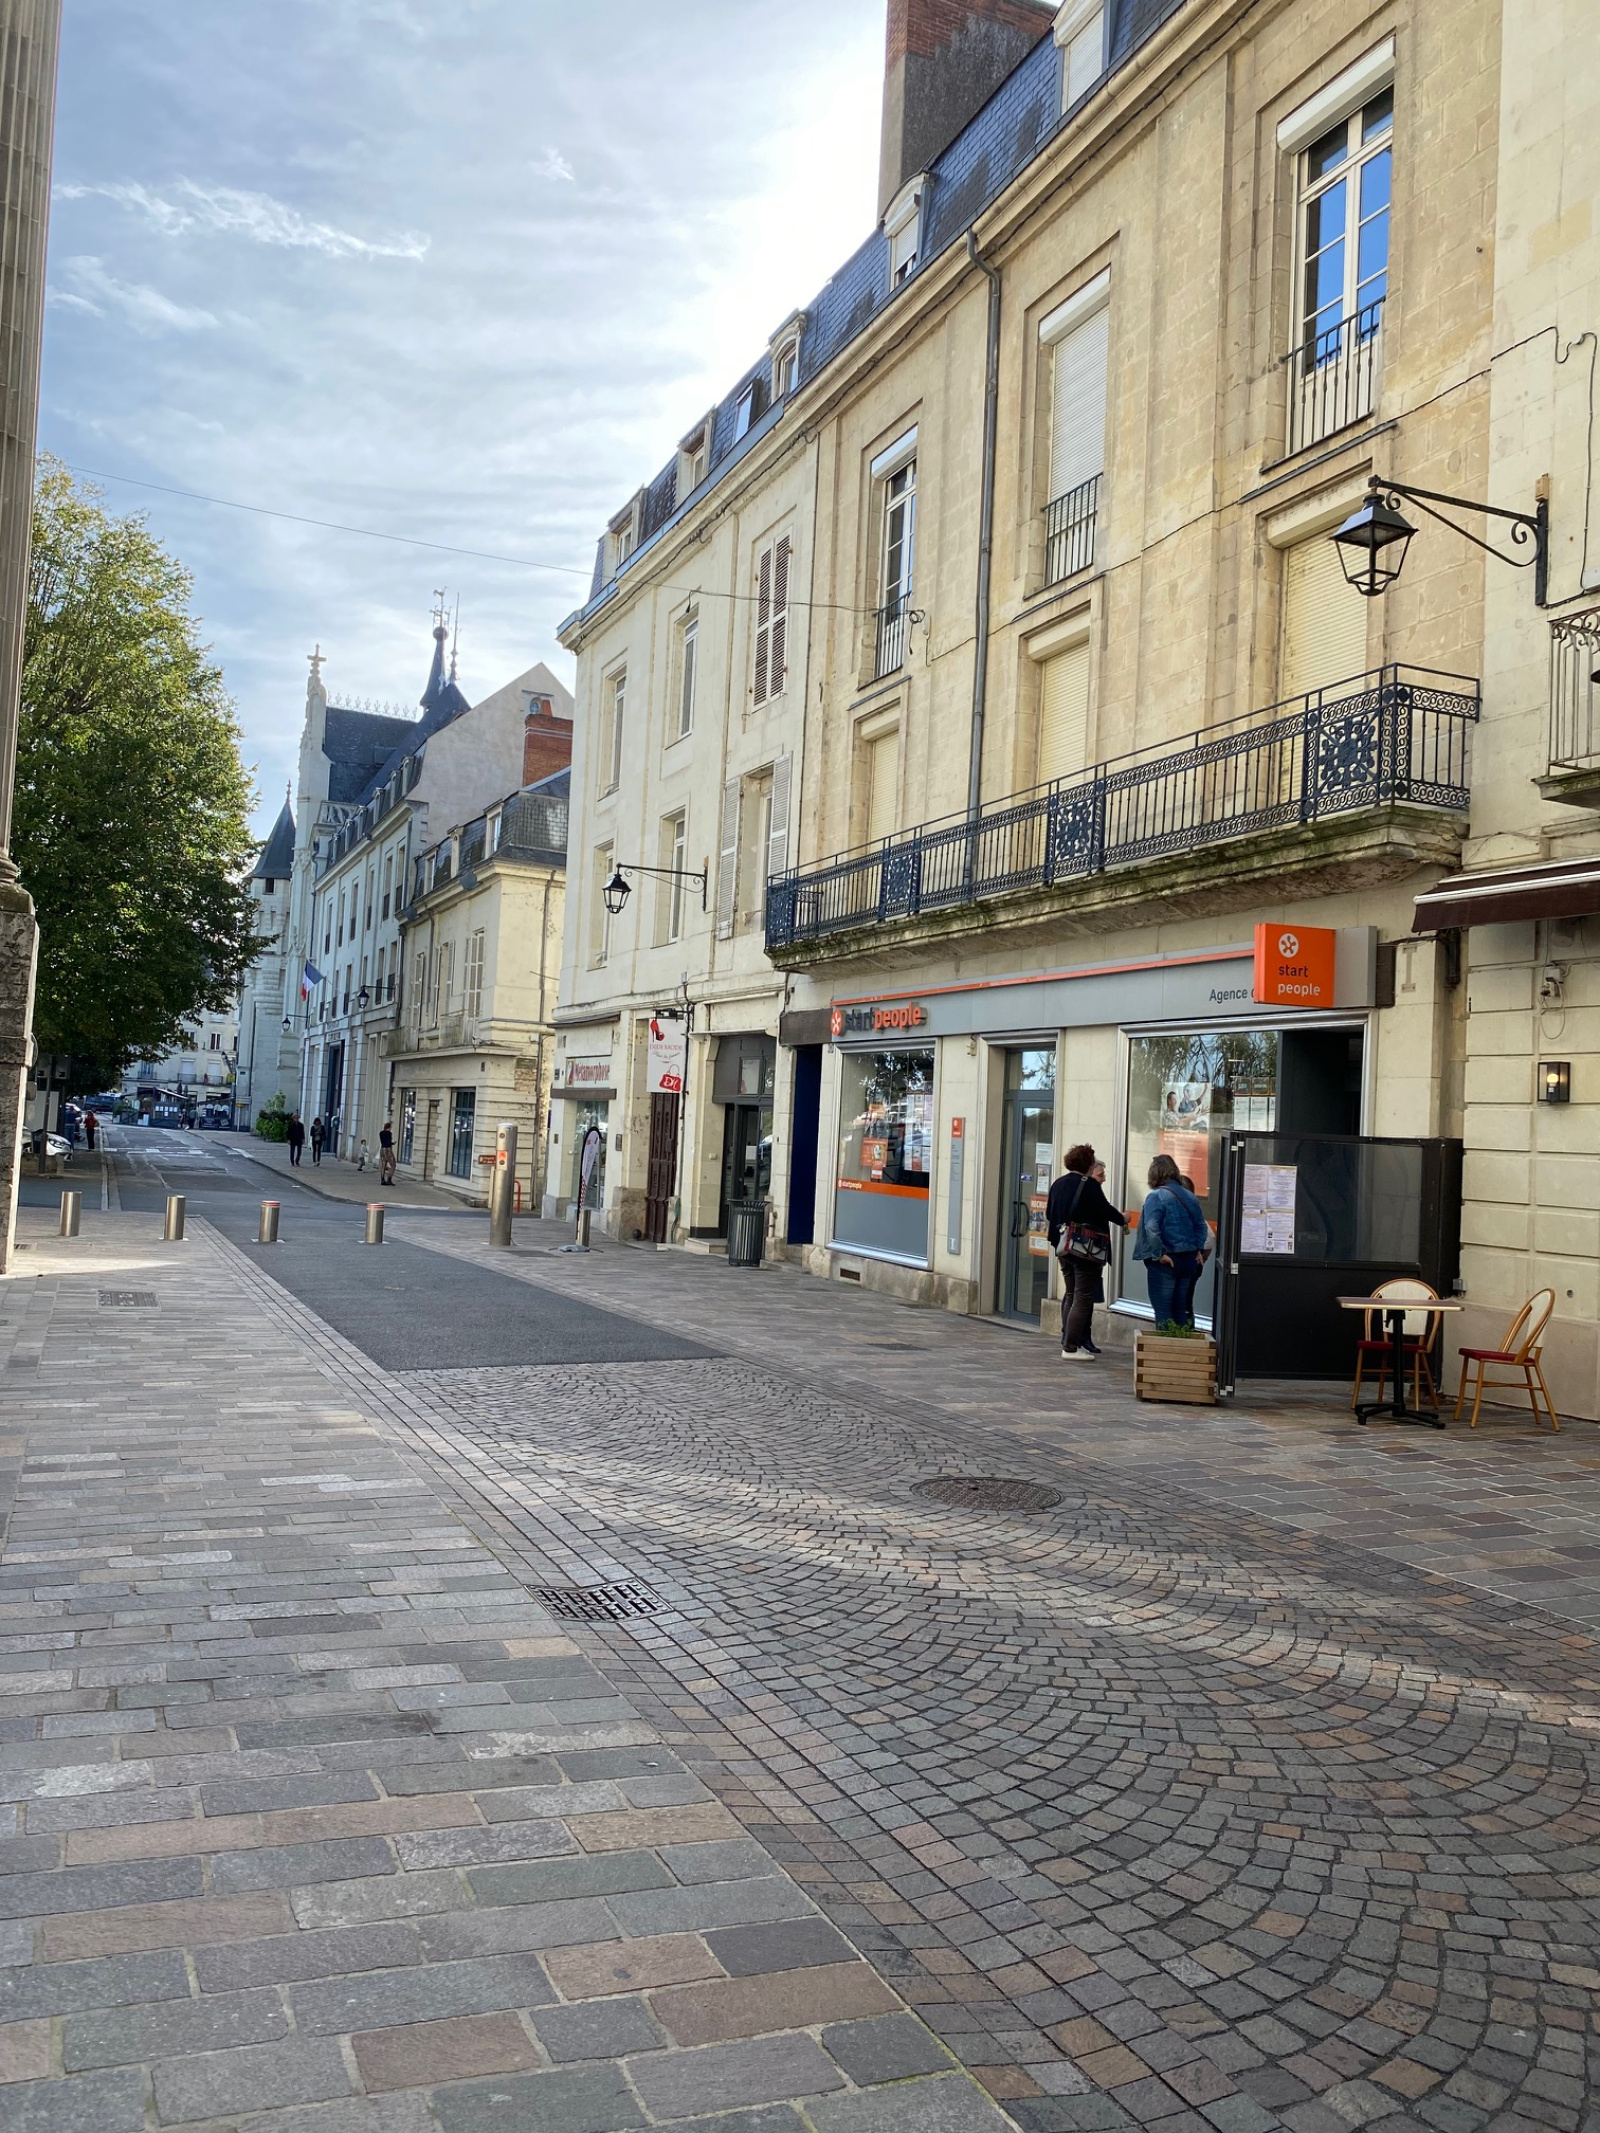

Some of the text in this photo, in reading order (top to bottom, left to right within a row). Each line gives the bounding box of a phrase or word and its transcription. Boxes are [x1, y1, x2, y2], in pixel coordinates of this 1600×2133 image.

[1278, 964, 1309, 978] start
[1208, 988, 1249, 1004] Agence
[1277, 982, 1321, 997] people
[664, 1043, 684, 1052] MODE
